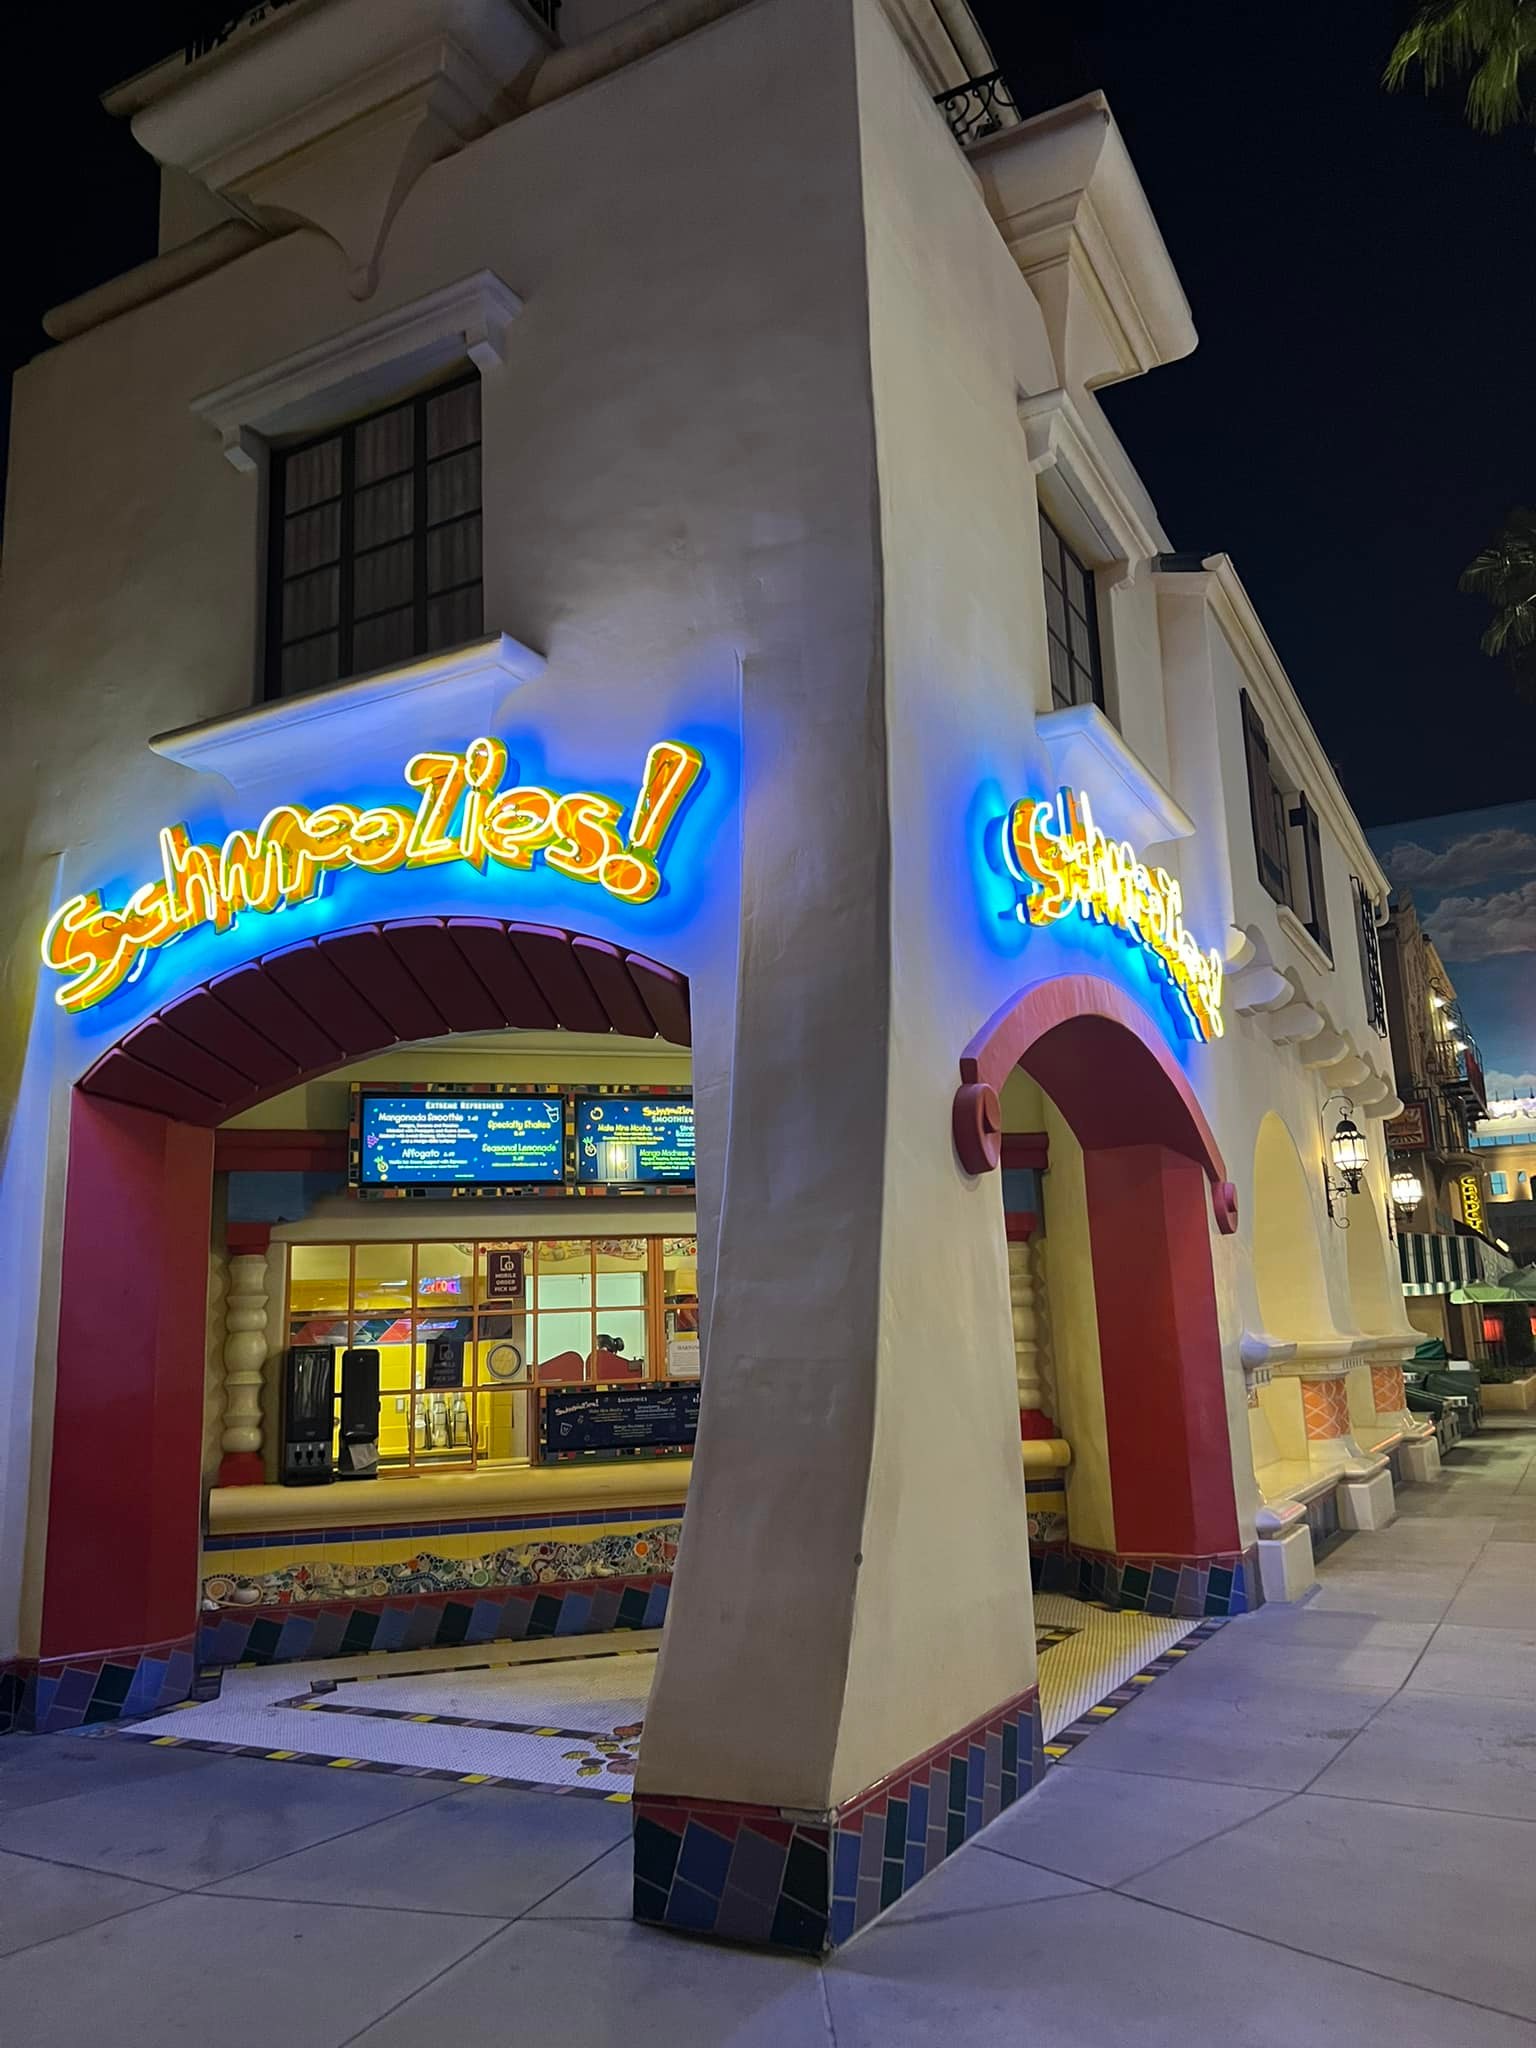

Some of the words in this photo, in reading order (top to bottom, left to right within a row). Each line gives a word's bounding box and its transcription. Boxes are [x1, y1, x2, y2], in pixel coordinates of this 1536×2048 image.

[378, 1112, 426, 1124] Mangonada
[427, 1112, 464, 1122] Smoothie
[651, 1115, 693, 1123] SMOOTHIES
[487, 1120, 524, 1131] Specialty
[524, 1120, 551, 1129] Shakes
[482, 1143, 518, 1153] Seasonal
[518, 1143, 557, 1153] Lemonade
[402, 1148, 441, 1160] Affogato
